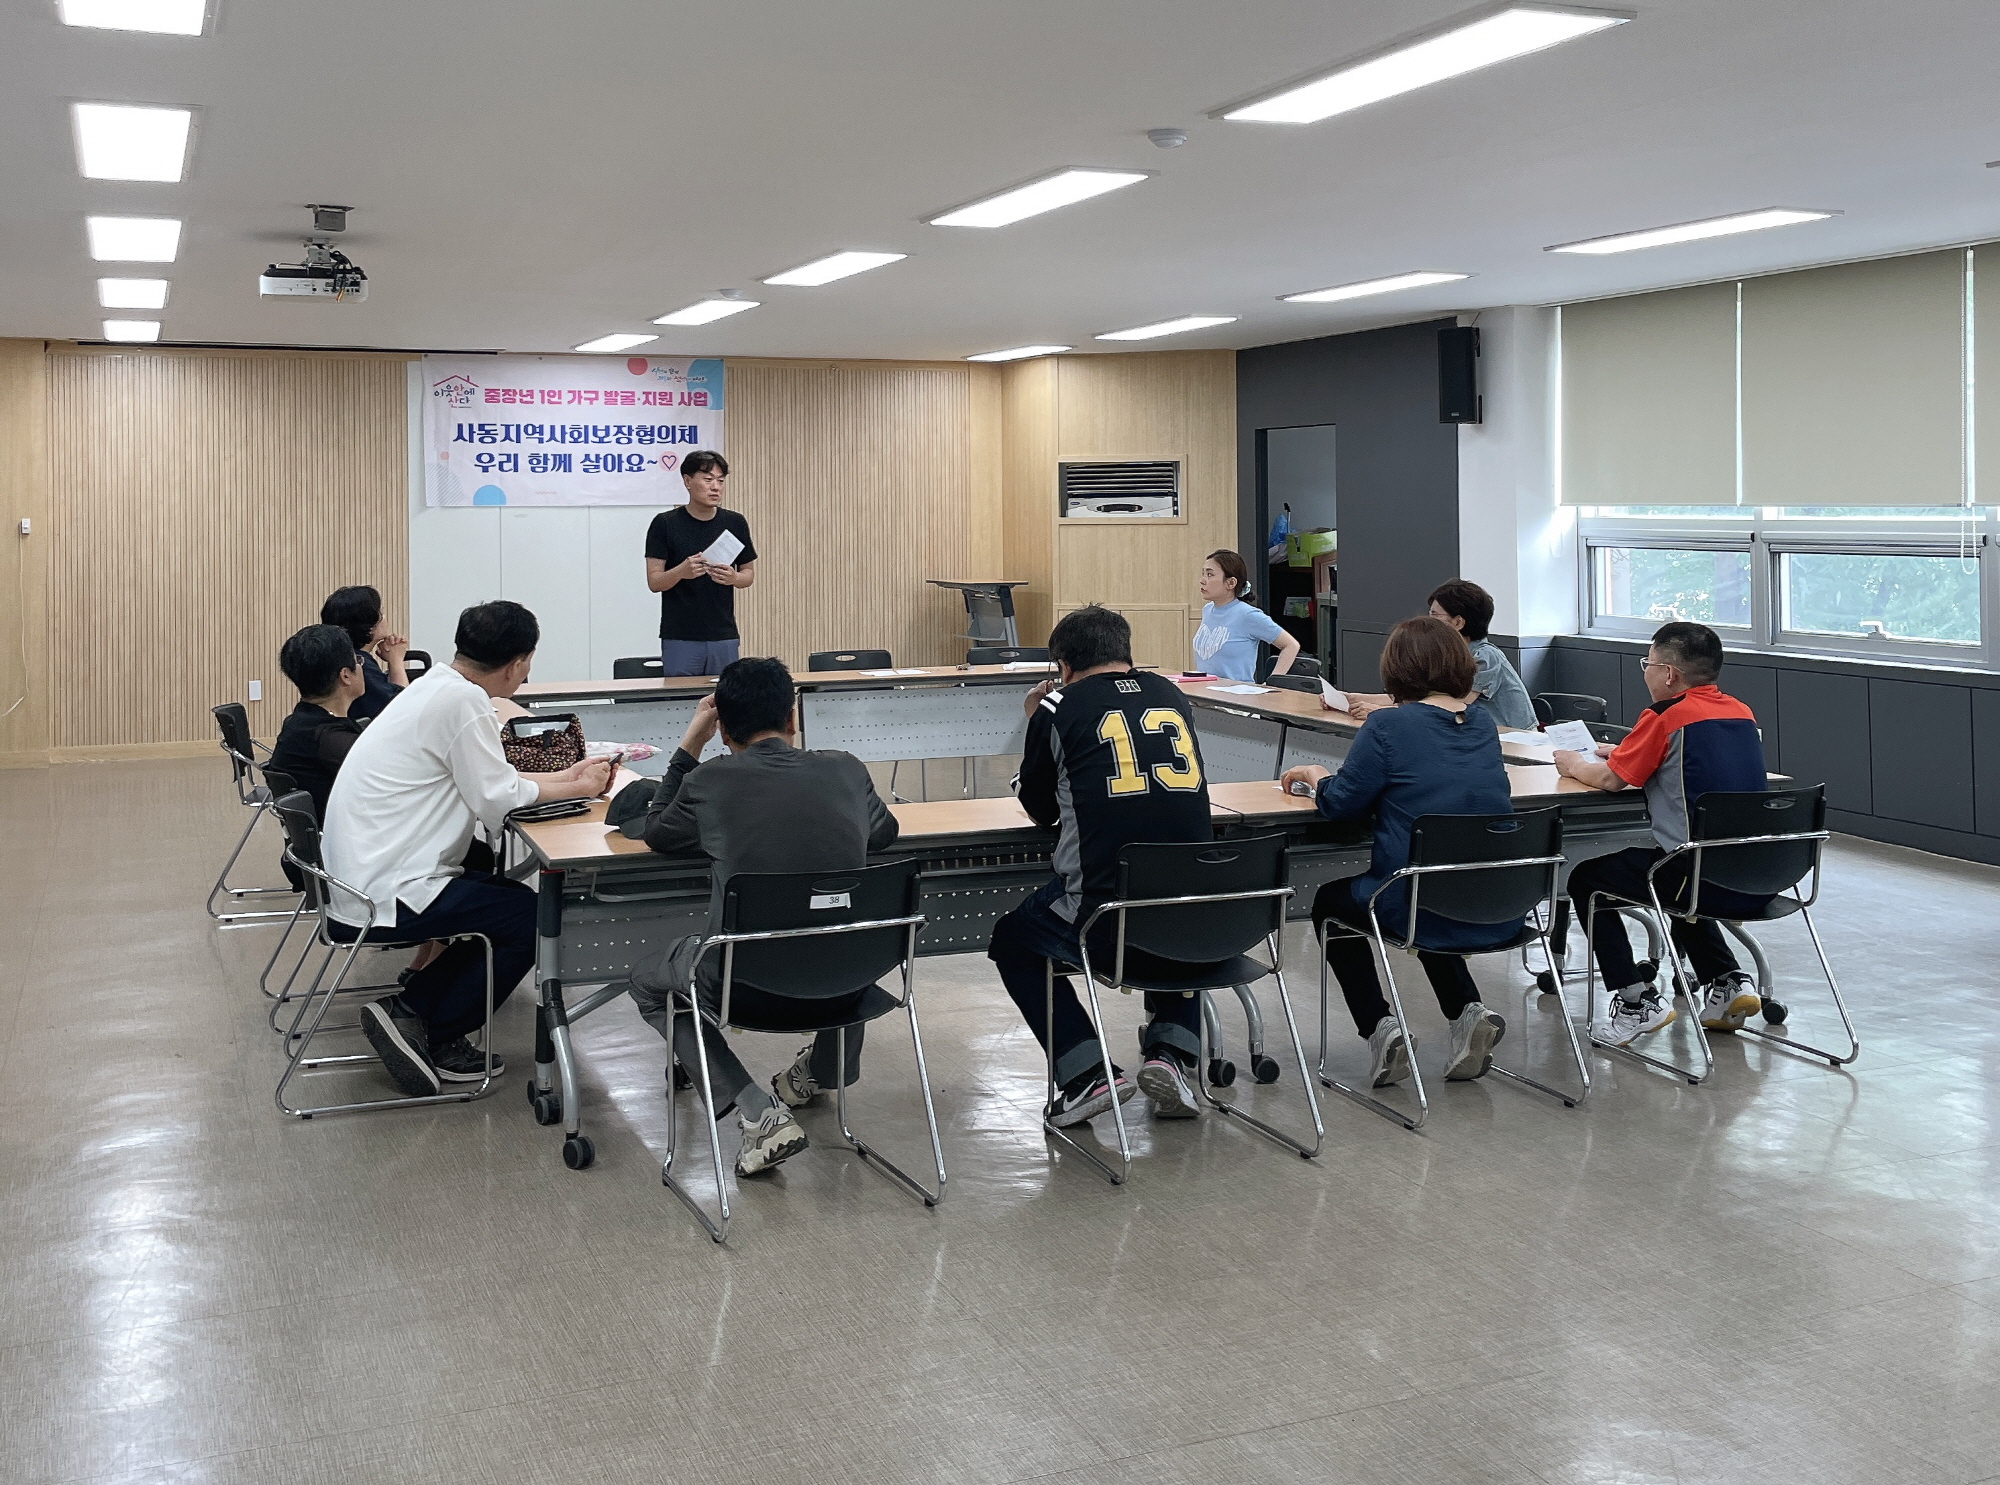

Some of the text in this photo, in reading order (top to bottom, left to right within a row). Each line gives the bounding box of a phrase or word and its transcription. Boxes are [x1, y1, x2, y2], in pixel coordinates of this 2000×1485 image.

[447, 396, 471, 409] 산다
[484, 388, 535, 405] 중장년
[539, 389, 563, 405] 1인
[567, 389, 600, 406] 가구
[678, 390, 708, 407] 사업
[453, 423, 699, 445] 사동지역사회보장협의체
[474, 452, 519, 474] 우리
[527, 453, 573, 474] 함께
[1096, 707, 1203, 798] 13
[829, 896, 840, 905] 38
